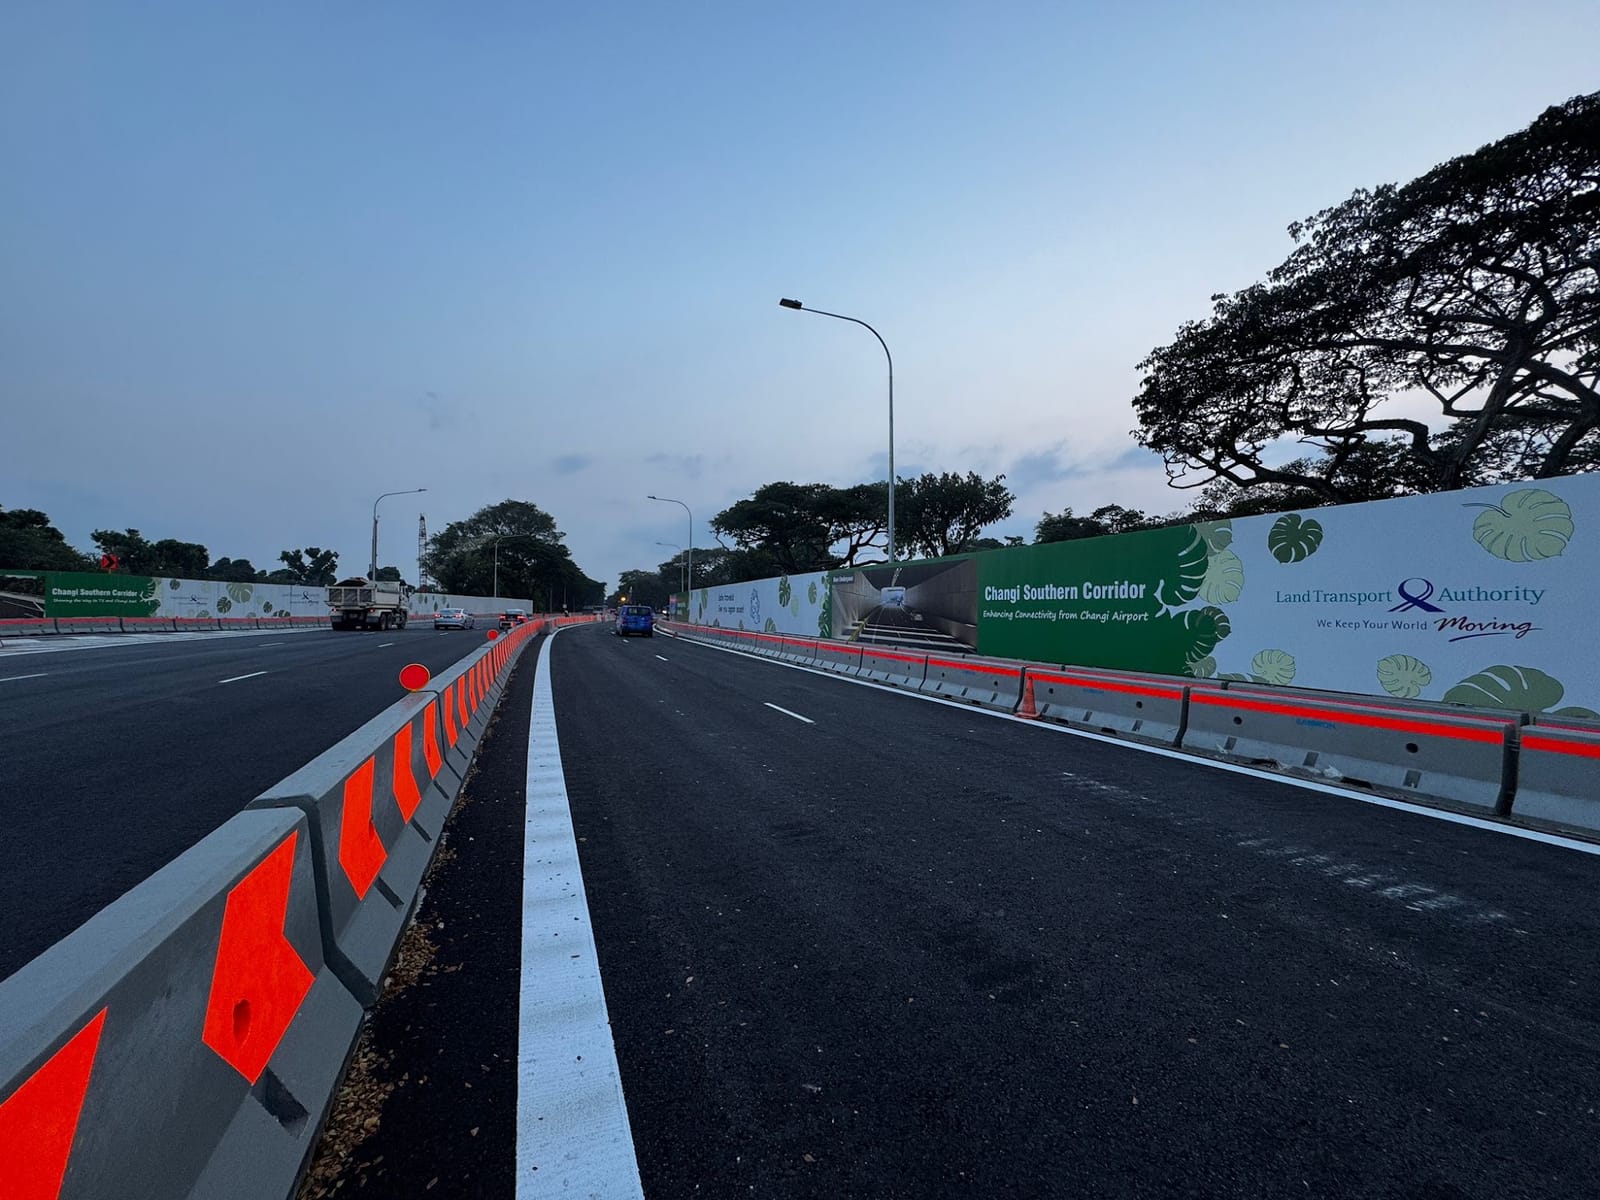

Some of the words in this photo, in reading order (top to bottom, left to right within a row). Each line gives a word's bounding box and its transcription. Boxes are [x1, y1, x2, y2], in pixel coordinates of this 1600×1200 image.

[52, 587, 79, 597] Changi
[79, 588, 111, 597] Southern
[112, 589, 138, 597] Corridor
[984, 585, 1020, 603] Changi
[1023, 583, 1078, 601] Southern
[1082, 580, 1146, 600] Corridor
[1275, 590, 1311, 603] Land
[1312, 589, 1393, 605] Transport
[1437, 585, 1546, 605] Authority
[983, 610, 1014, 621] Enhancing
[1014, 609, 1057, 622] Connectivity
[1058, 609, 1078, 620] from
[1080, 610, 1110, 623] Changi
[1111, 611, 1149, 624] Airport
[1316, 618, 1332, 628] We
[1335, 619, 1361, 631] Keep
[1363, 620, 1389, 630] Your
[1391, 620, 1428, 631] World
[1433, 615, 1544, 639] Moving
